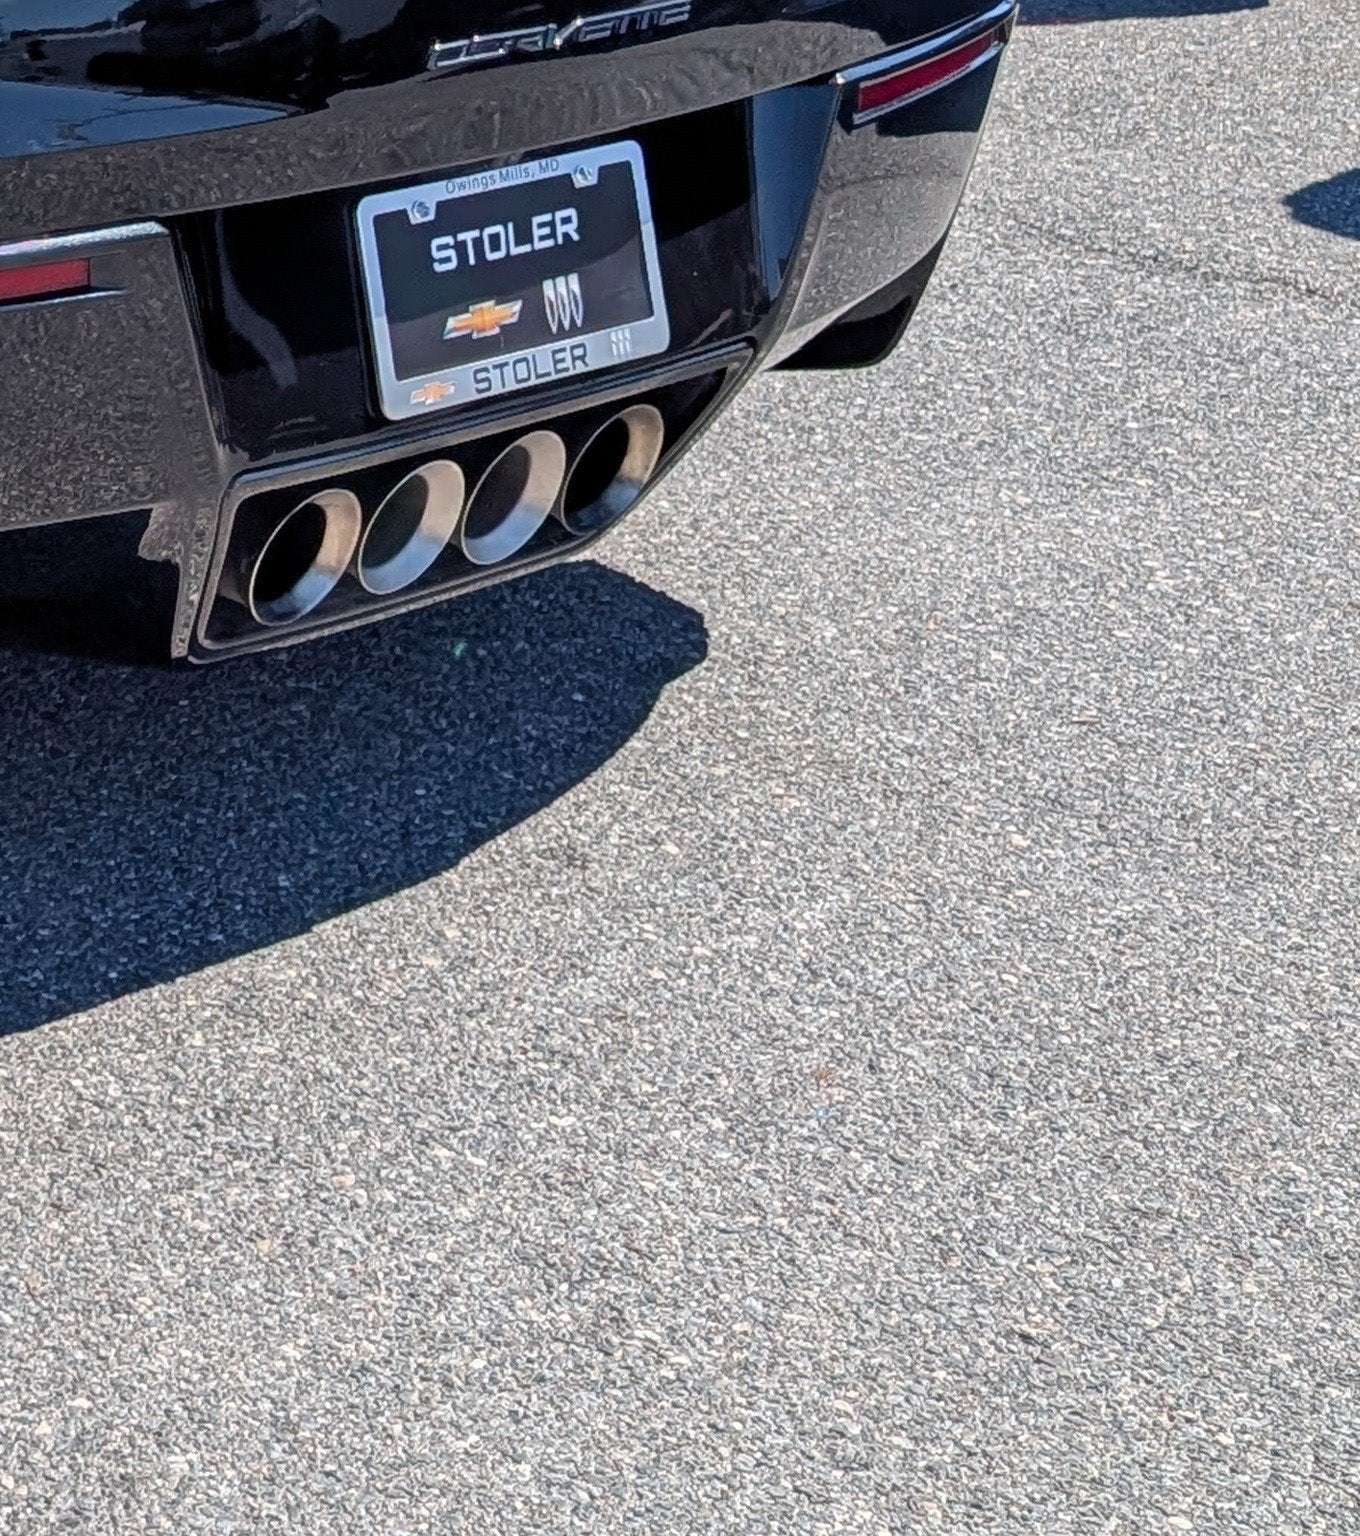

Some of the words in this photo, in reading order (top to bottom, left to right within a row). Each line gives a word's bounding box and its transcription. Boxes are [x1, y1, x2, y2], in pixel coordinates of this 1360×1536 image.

[445, 173, 497, 194] Owings
[499, 165, 536, 183] Mills,
[538, 158, 560, 174] MD
[431, 207, 581, 273] STOLER
[472, 342, 590, 394] STOLER
